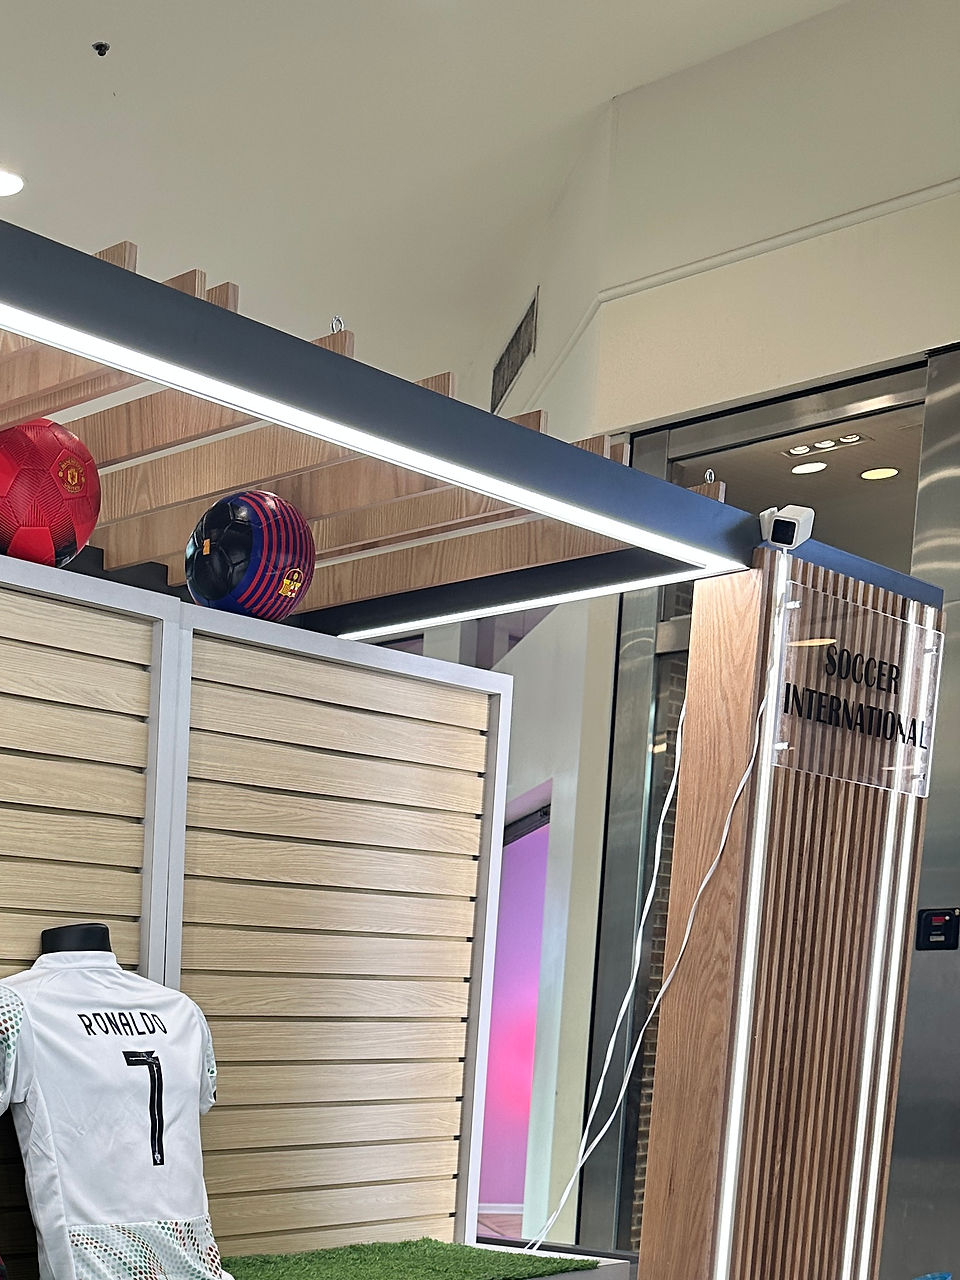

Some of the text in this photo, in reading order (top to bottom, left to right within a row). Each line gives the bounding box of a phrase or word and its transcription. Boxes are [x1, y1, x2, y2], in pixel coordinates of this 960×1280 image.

[825, 644, 901, 695] SOCCER
[783, 682, 928, 750] INTERNATIONAL
[76, 1012, 168, 1036] RONALDO
[121, 1050, 165, 1166] 7
